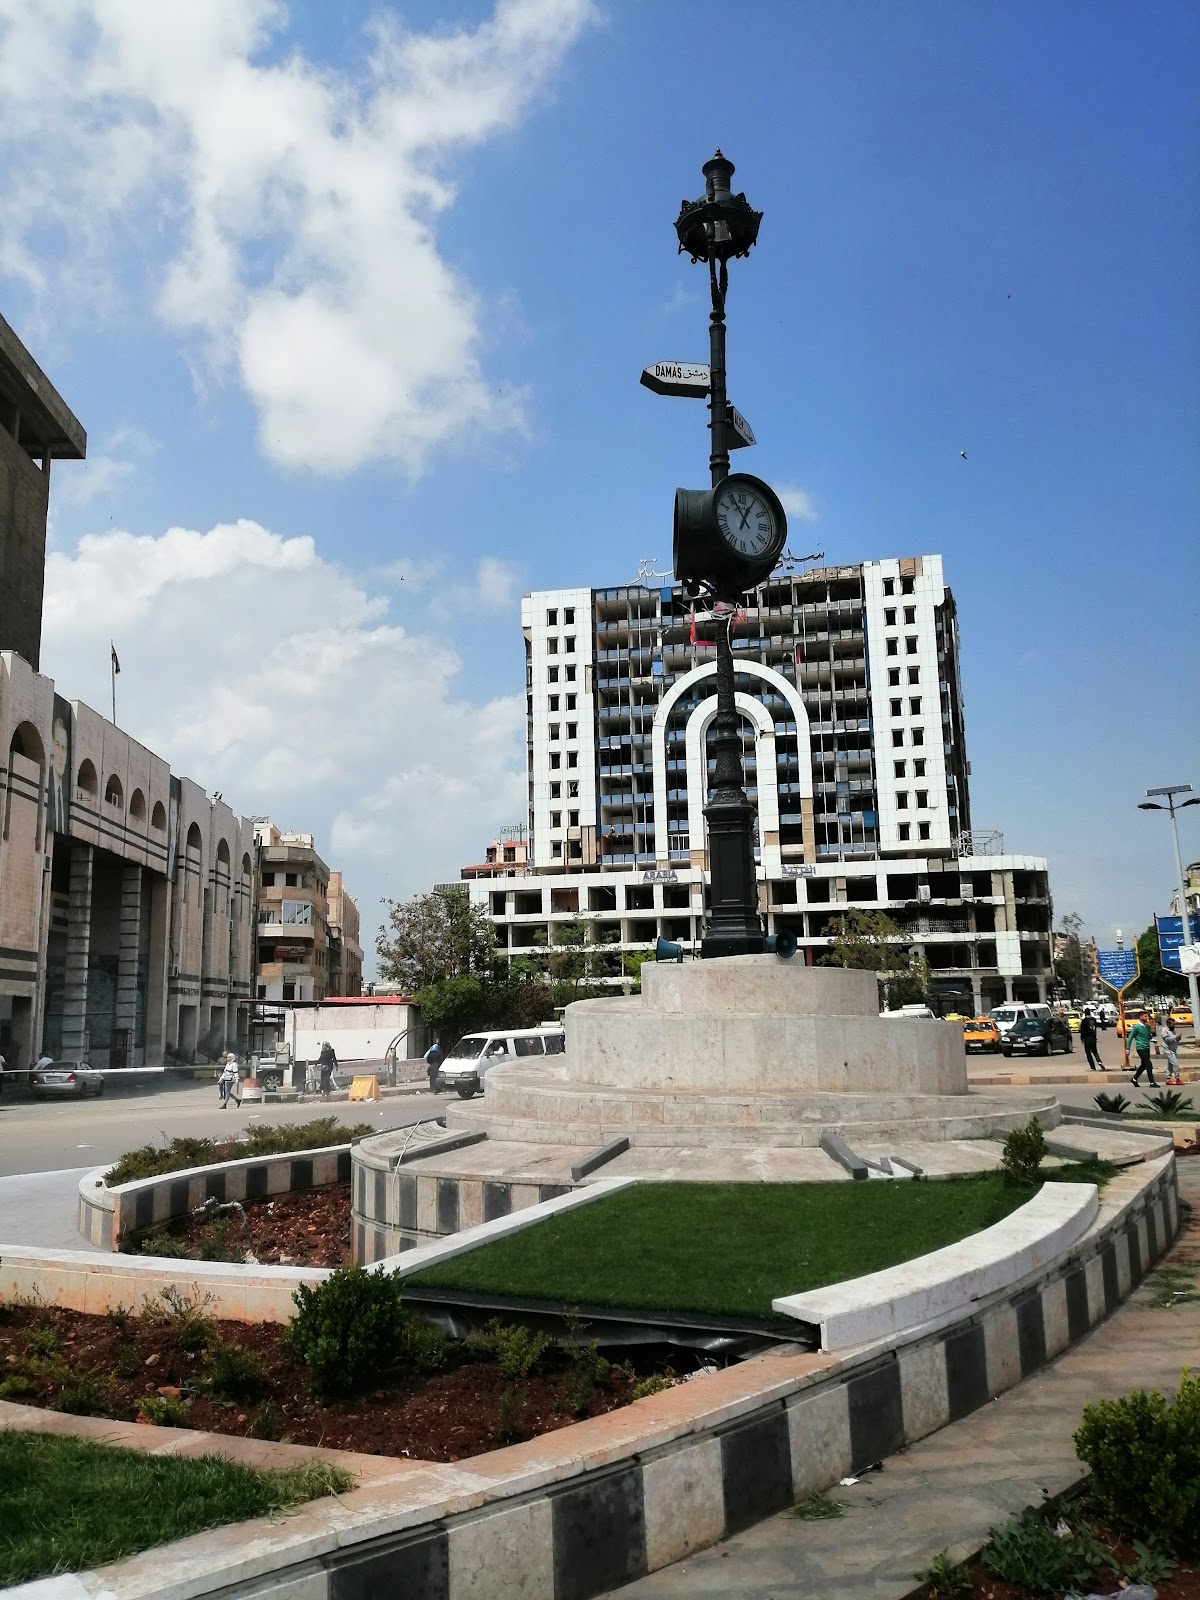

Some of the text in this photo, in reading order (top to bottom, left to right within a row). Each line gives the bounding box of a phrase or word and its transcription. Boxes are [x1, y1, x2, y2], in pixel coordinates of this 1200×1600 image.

[655, 365, 682, 379] DAMAS
[683, 369, 708, 380] دمشق
[643, 870, 677, 879] ARABIA
